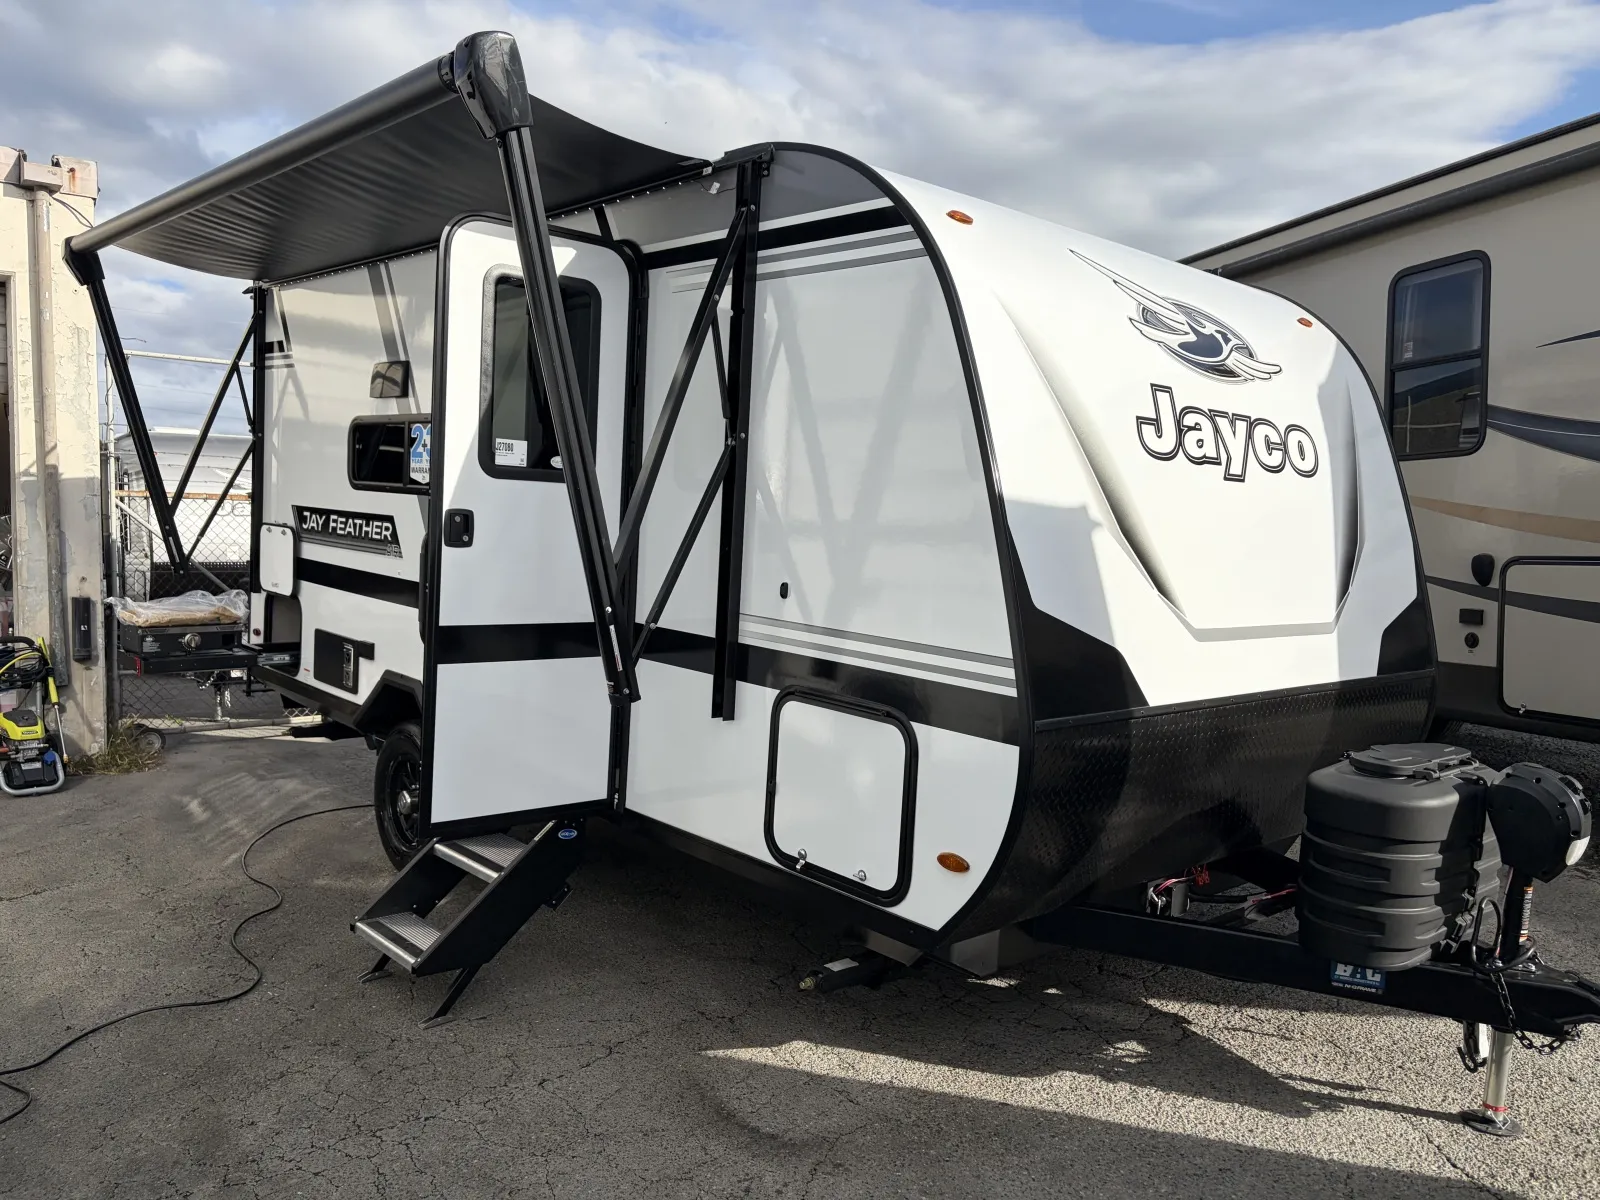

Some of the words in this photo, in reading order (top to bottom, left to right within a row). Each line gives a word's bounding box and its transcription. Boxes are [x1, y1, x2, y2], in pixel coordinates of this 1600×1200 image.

[1136, 383, 1319, 483] Jayco
[302, 511, 326, 532] JAY
[328, 514, 393, 541] FEATHER
